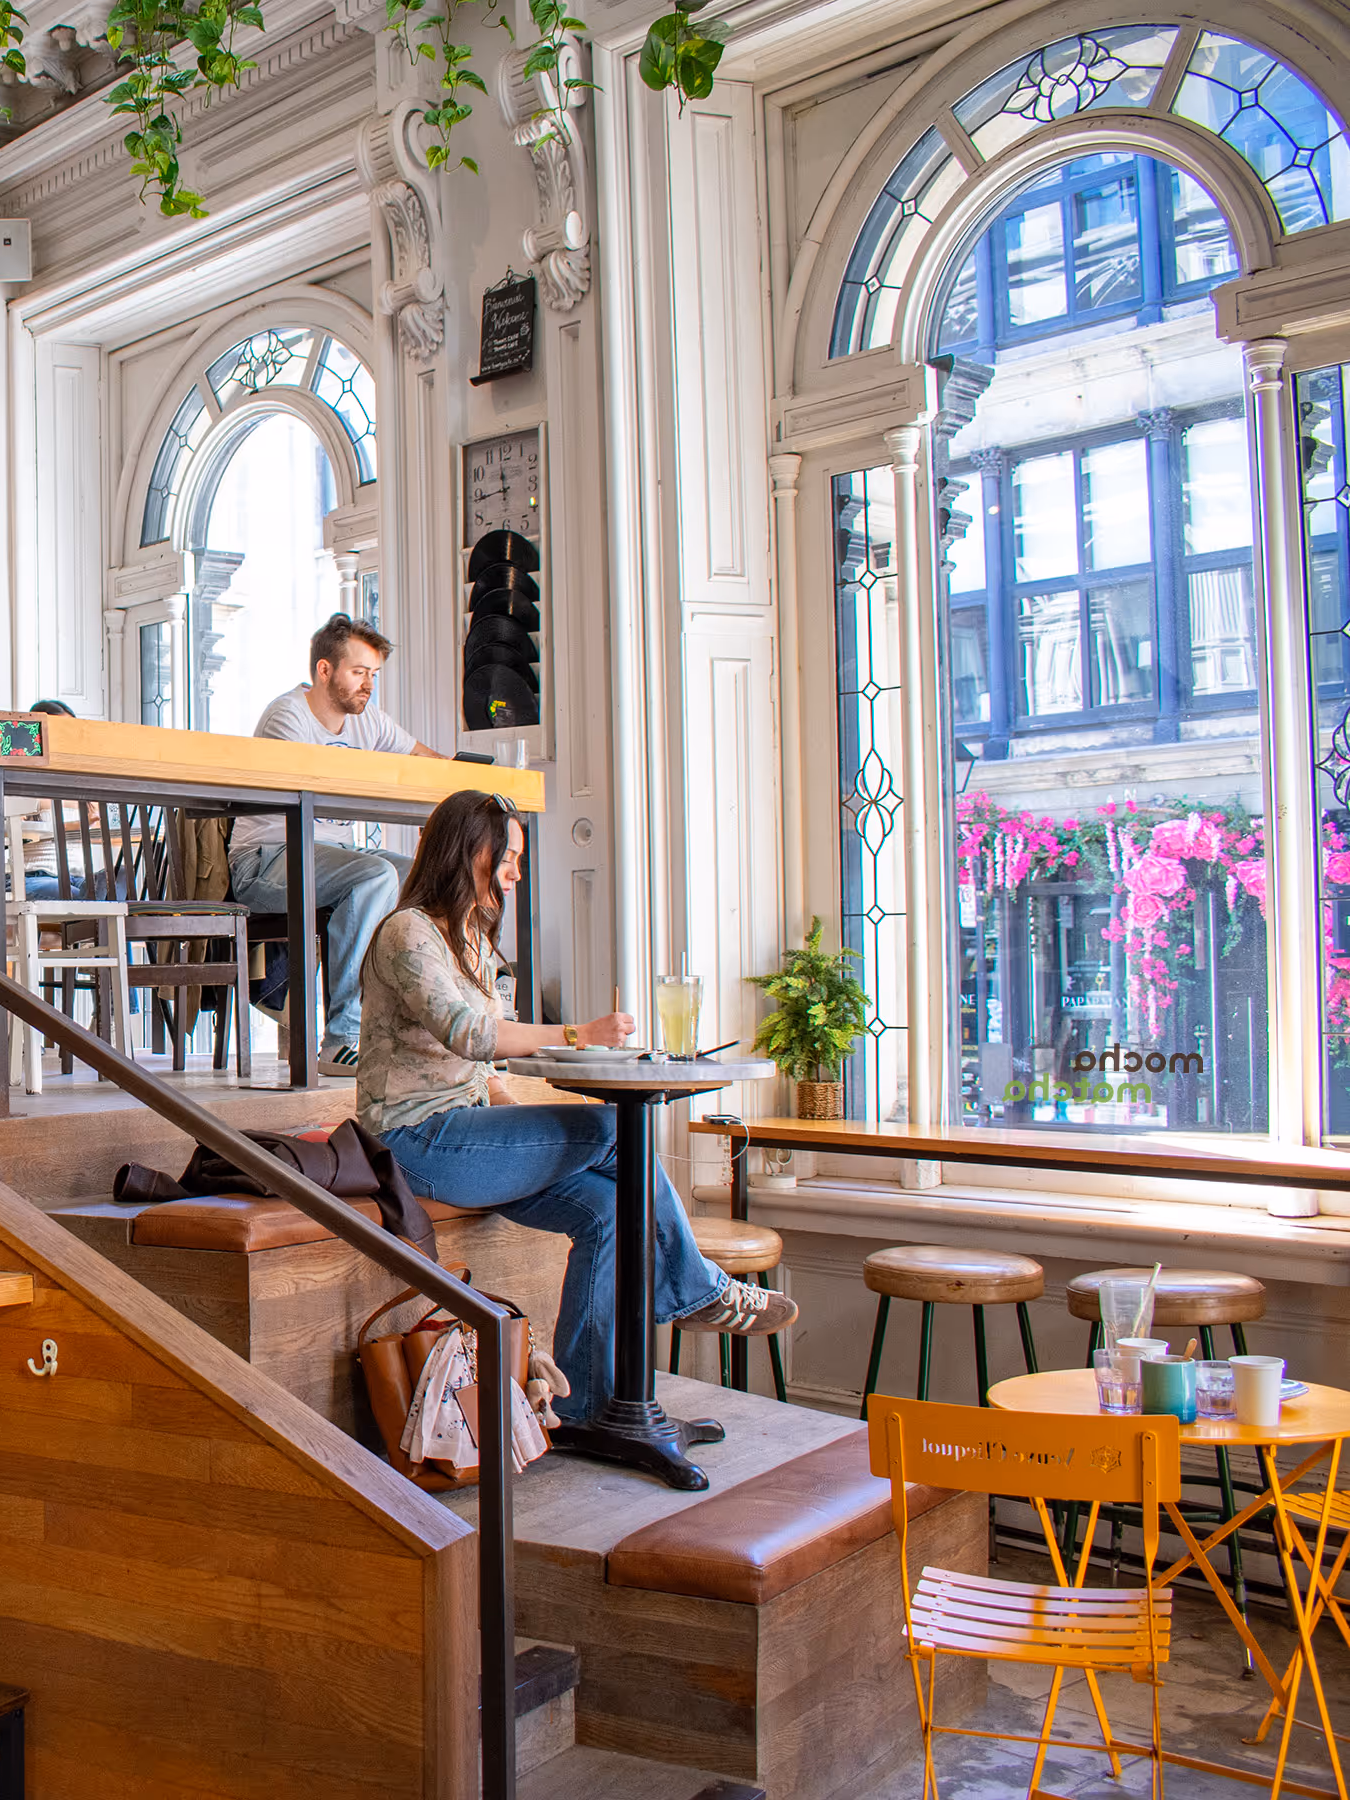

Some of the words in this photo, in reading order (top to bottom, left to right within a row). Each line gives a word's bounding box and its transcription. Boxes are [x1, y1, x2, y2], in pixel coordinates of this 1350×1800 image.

[486, 449, 493, 465] 11
[499, 444, 512, 462] 12
[528, 453, 538, 470] 2
[473, 465, 485, 482] 10
[528, 474, 538, 492] 3
[474, 508, 484, 526] 8
[520, 514, 530, 530] 5
